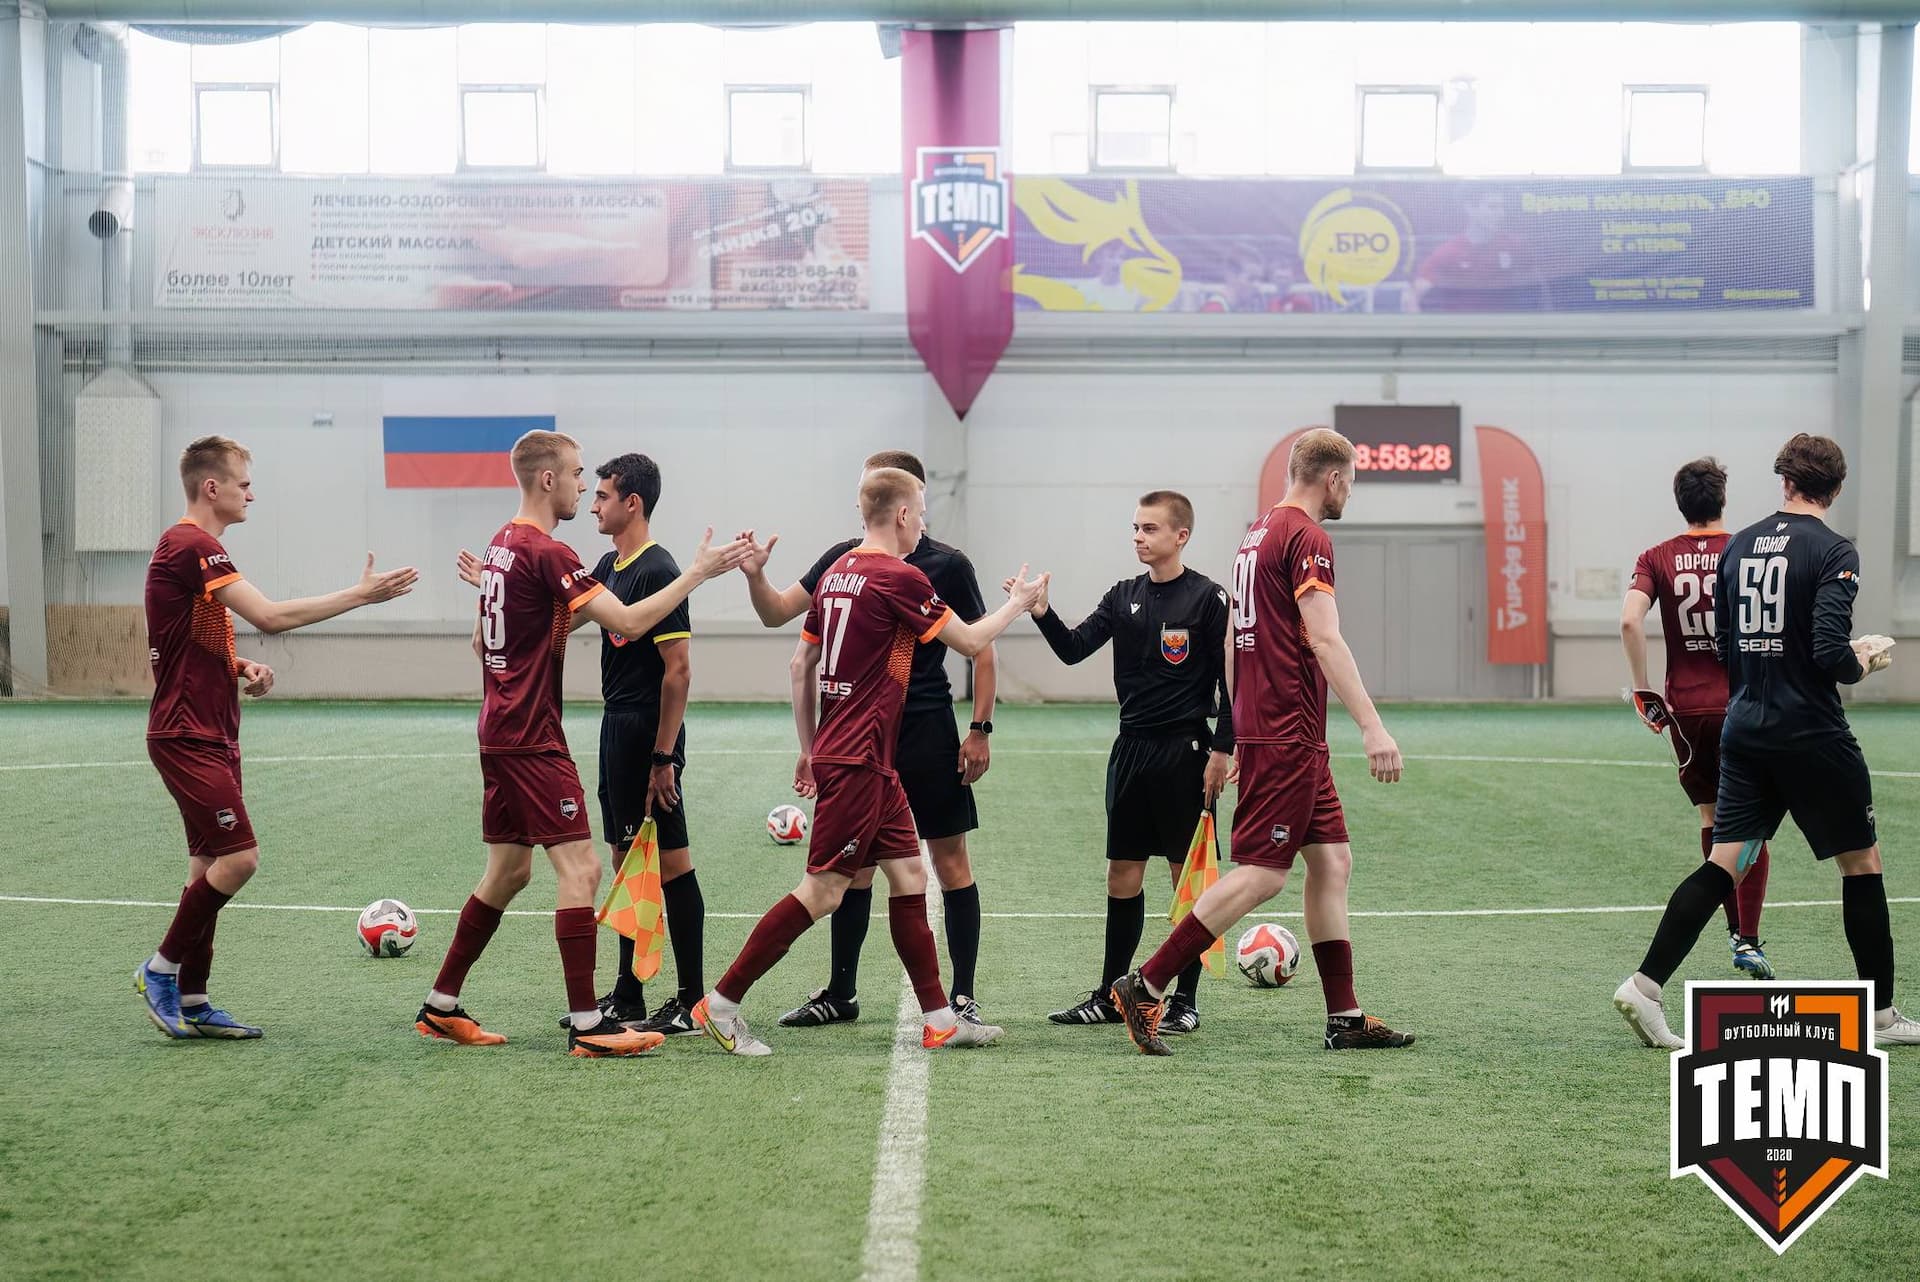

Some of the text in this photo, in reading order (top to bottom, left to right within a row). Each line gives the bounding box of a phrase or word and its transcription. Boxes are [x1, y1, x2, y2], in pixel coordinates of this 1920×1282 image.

[920, 182, 999, 225] ТЕМП
[311, 234, 392, 250] ДЕТСКИЙ
[167, 270, 230, 287] более
[1753, 535, 1790, 554] ПАНОВ
[1675, 553, 1720, 571] ВОРОН
[1233, 550, 1258, 630] 90
[1739, 555, 1789, 634] 59
[820, 597, 853, 677] 17
